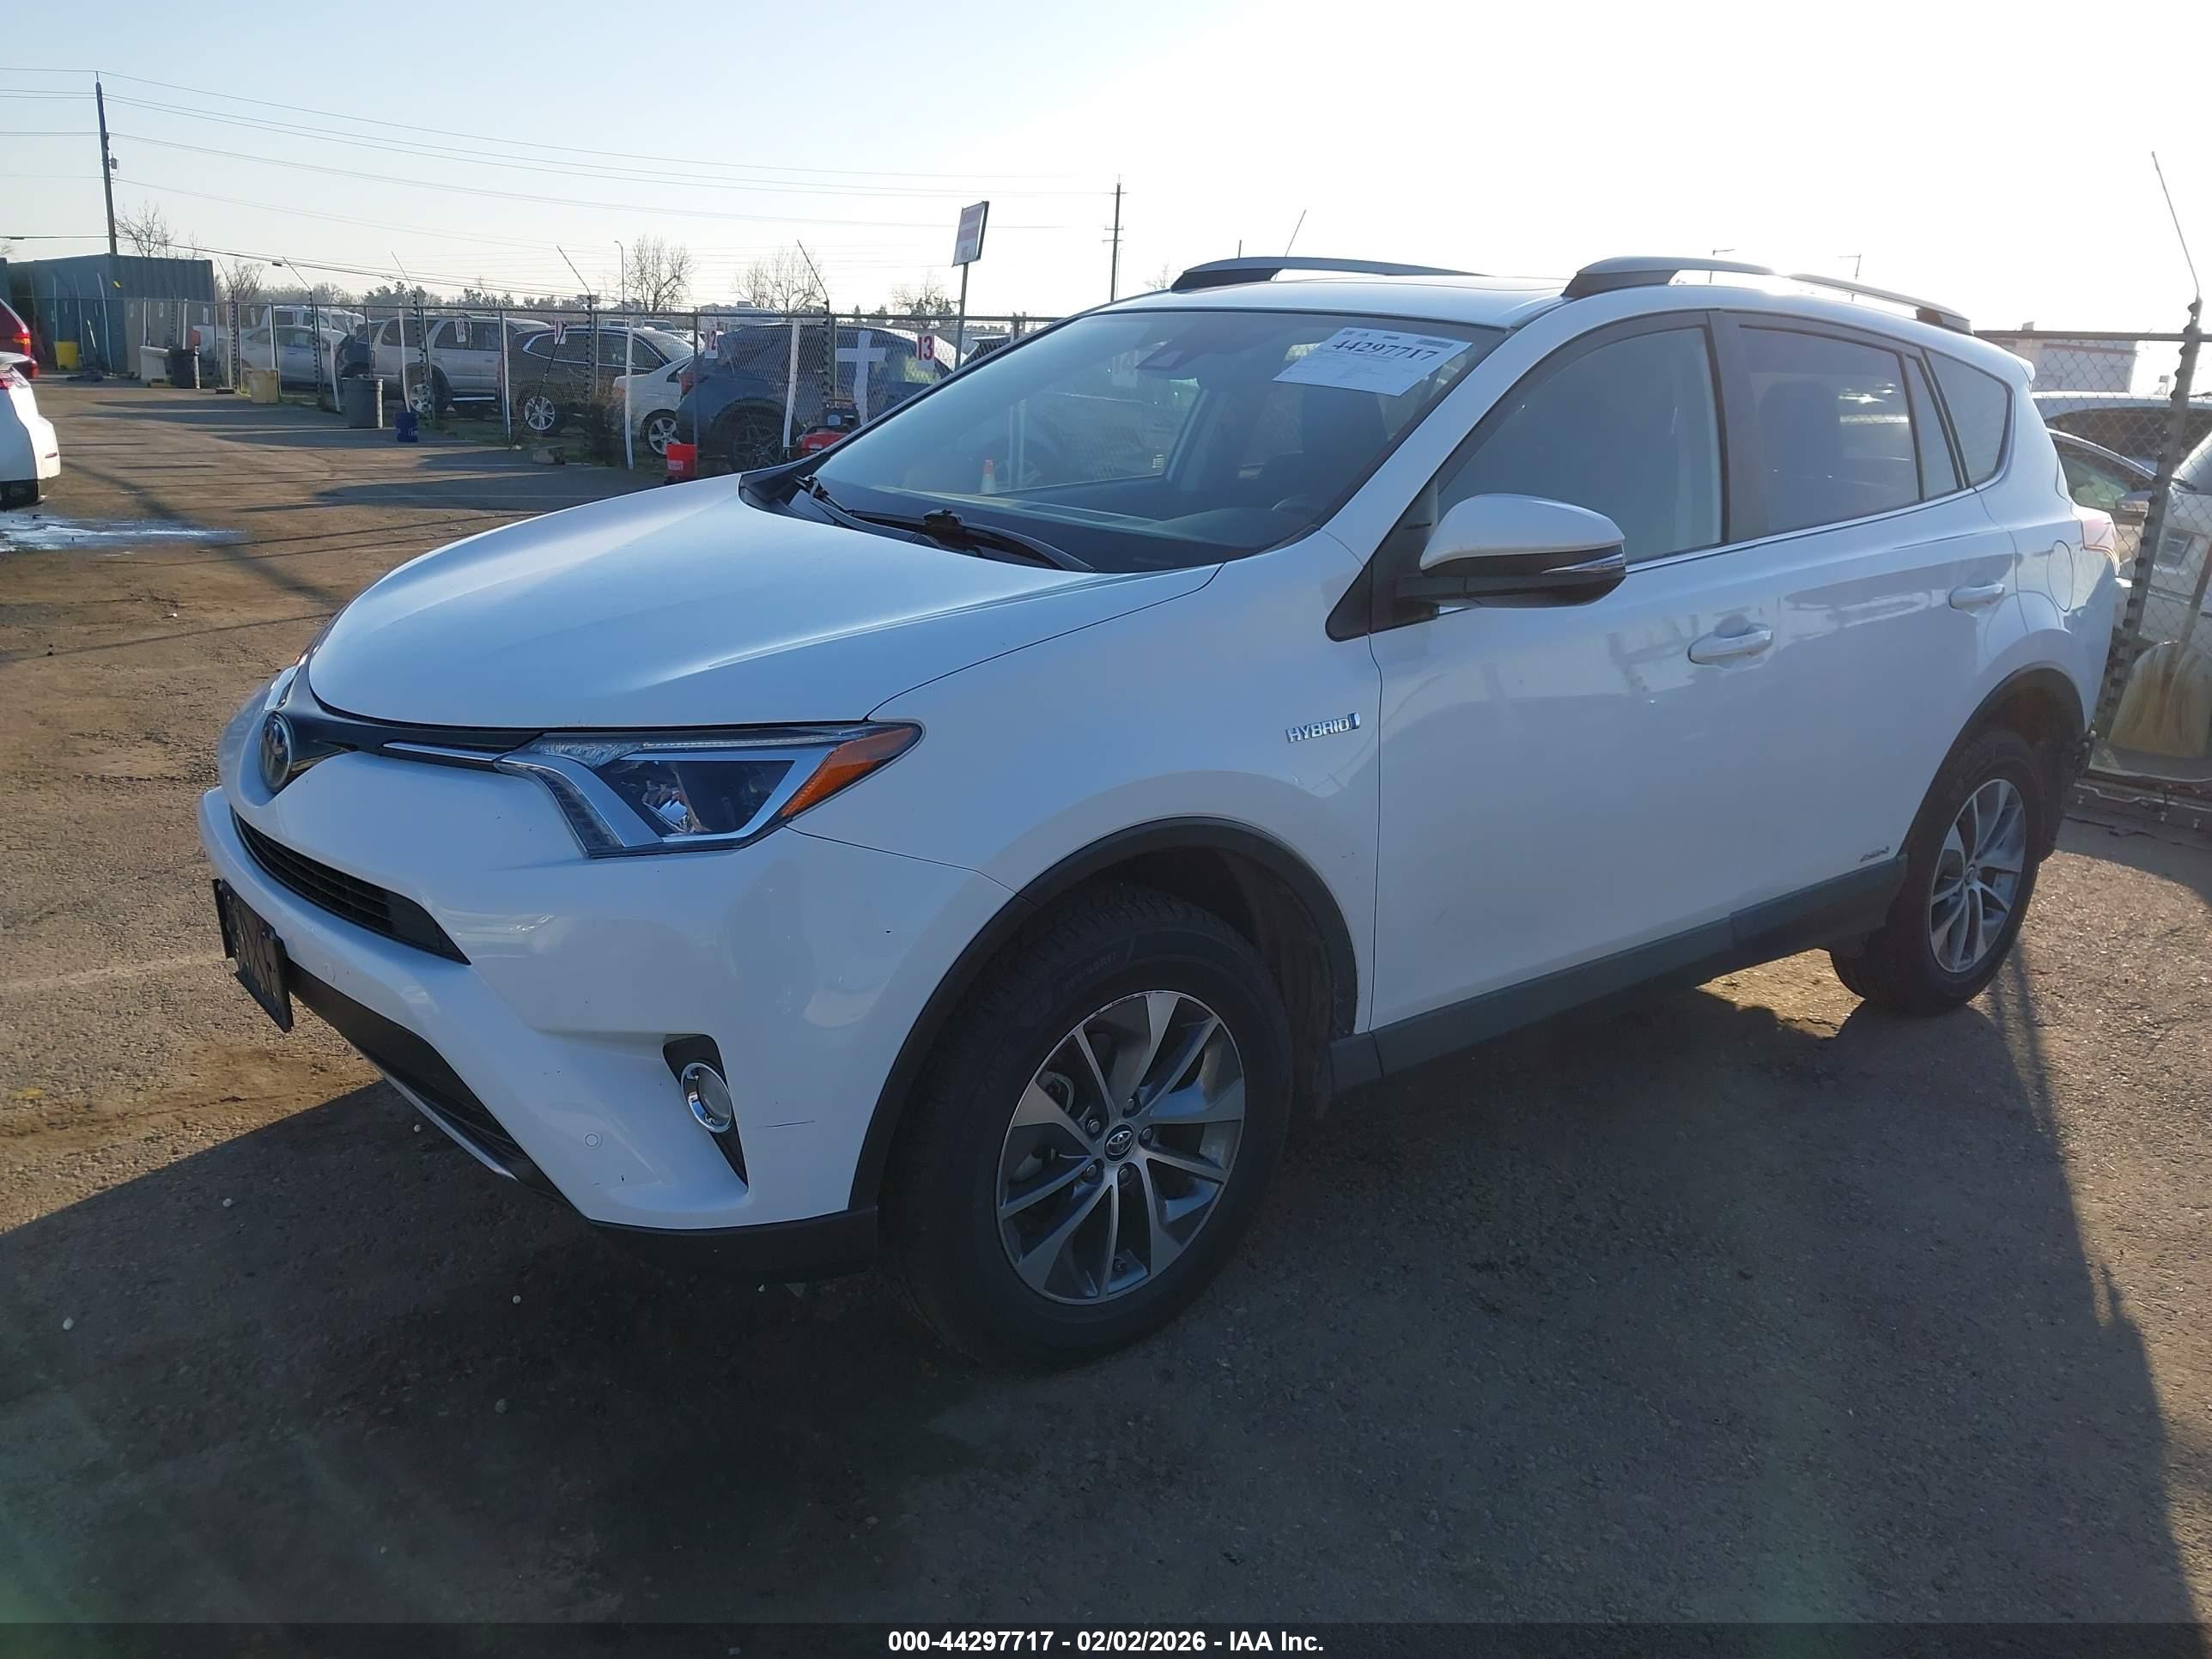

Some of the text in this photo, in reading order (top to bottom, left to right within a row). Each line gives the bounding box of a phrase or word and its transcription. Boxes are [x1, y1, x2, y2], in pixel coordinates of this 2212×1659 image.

[918, 335, 933, 361] 13
[1334, 341, 1440, 361] 44297717
[1286, 717, 1350, 743] HYBRID
